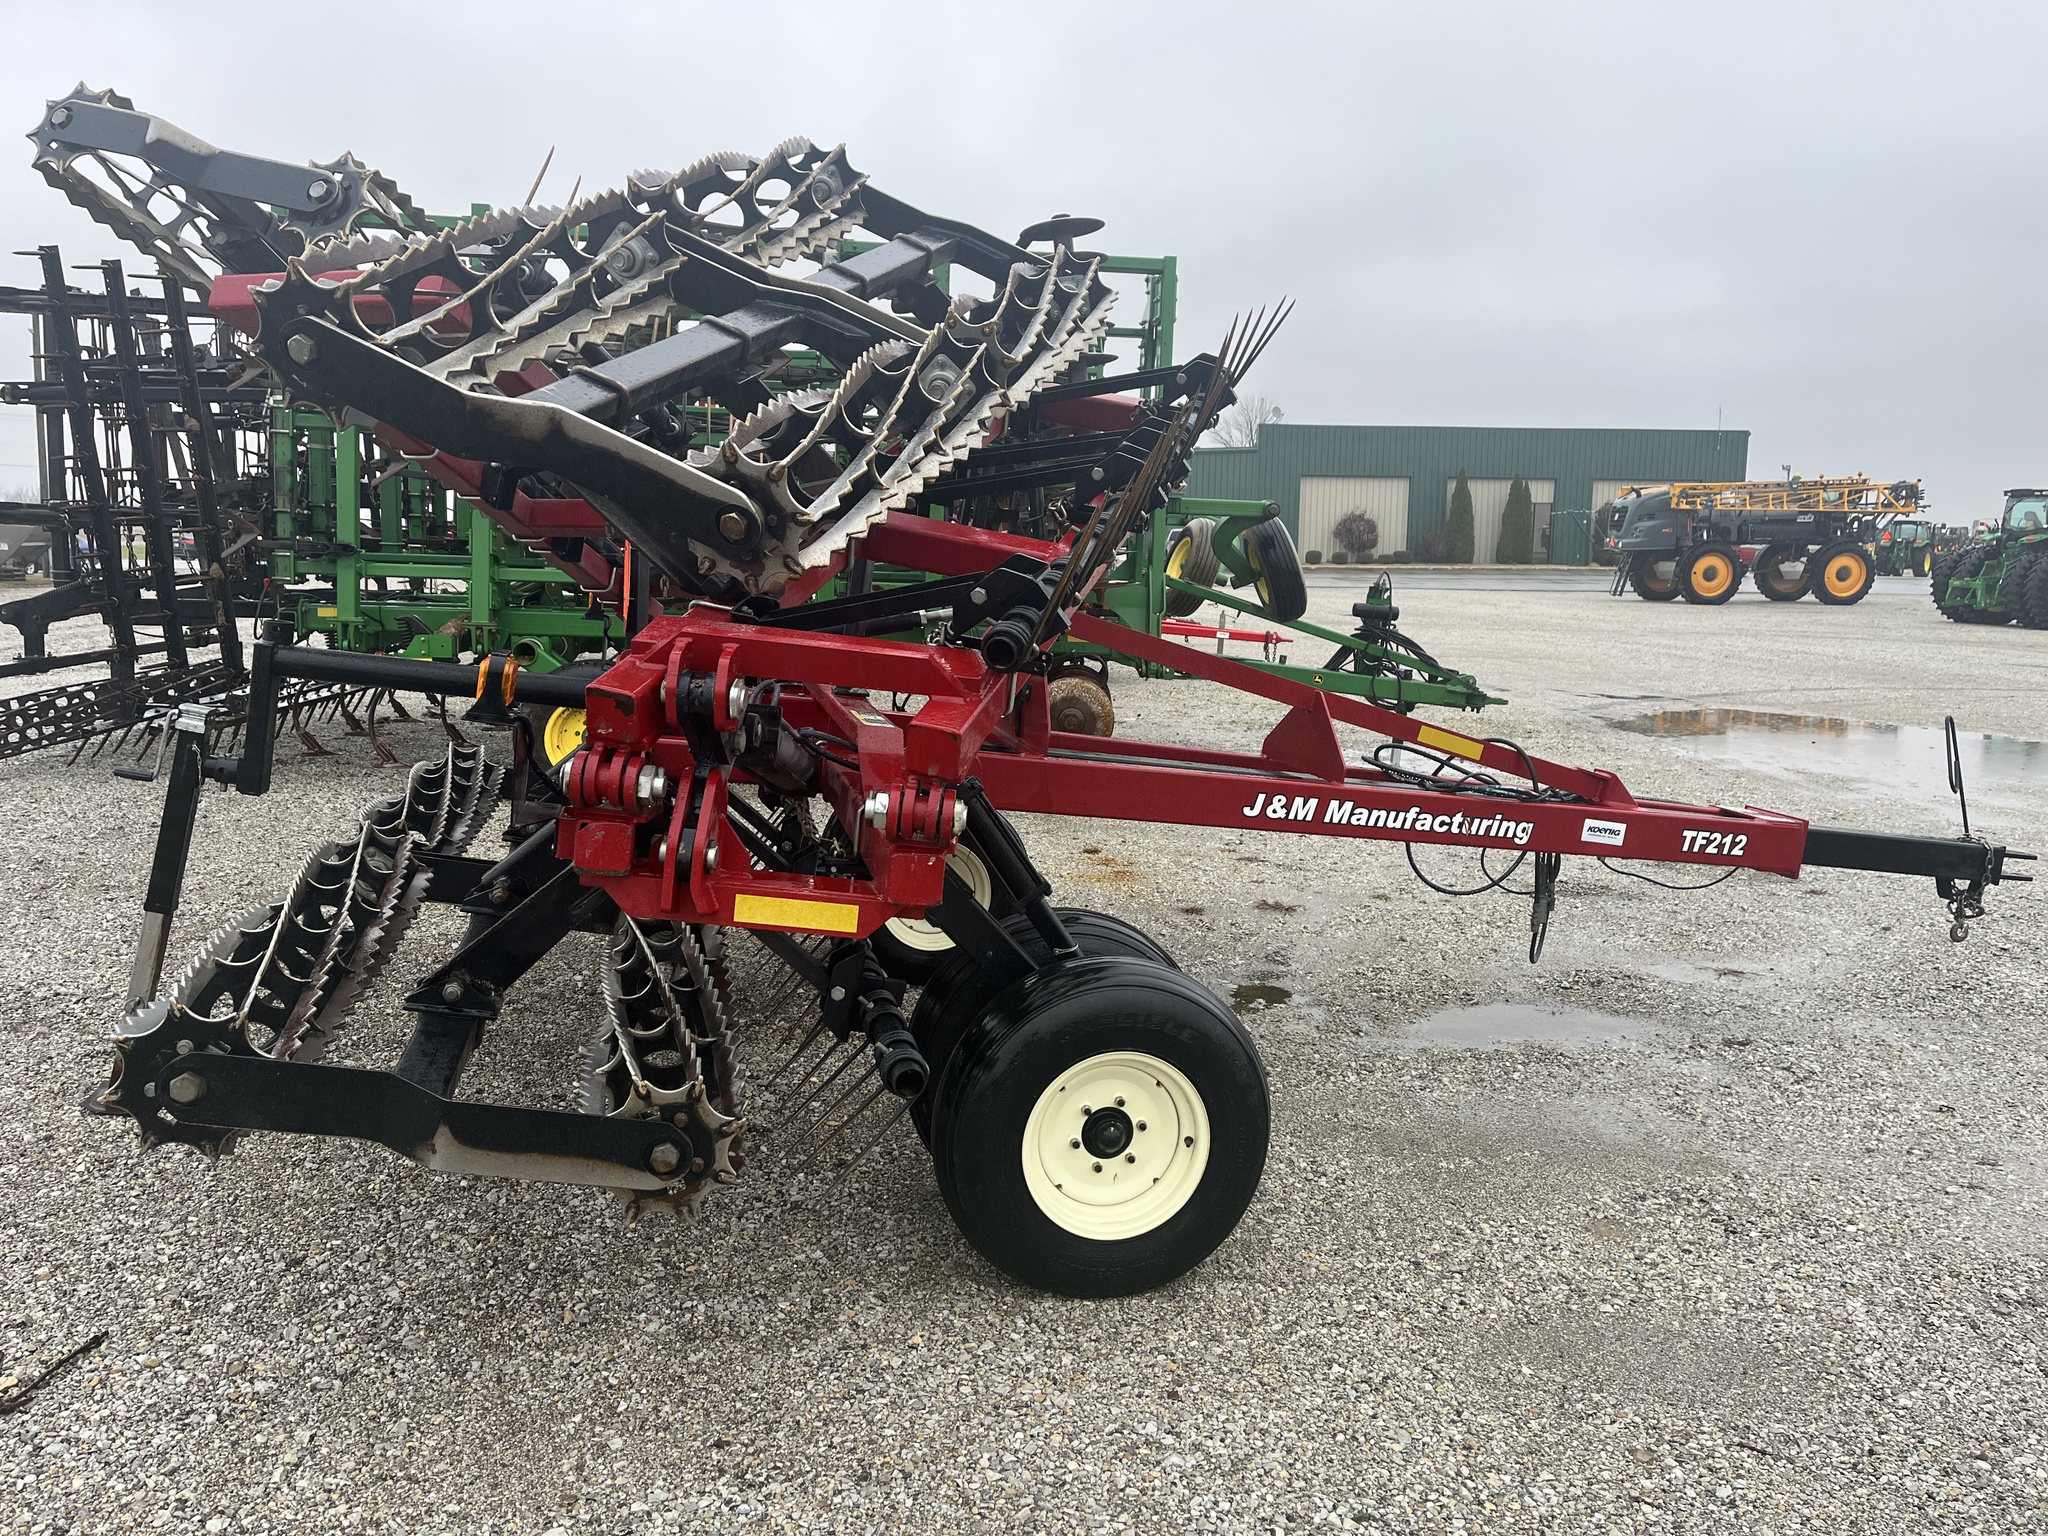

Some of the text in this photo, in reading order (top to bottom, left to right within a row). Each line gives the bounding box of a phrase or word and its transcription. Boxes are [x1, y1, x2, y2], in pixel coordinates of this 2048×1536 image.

[1242, 792, 1535, 845] J&M Manufacturing
[1681, 829, 1748, 857] TF212
[1058, 1011, 1201, 1046] CARLISLE
